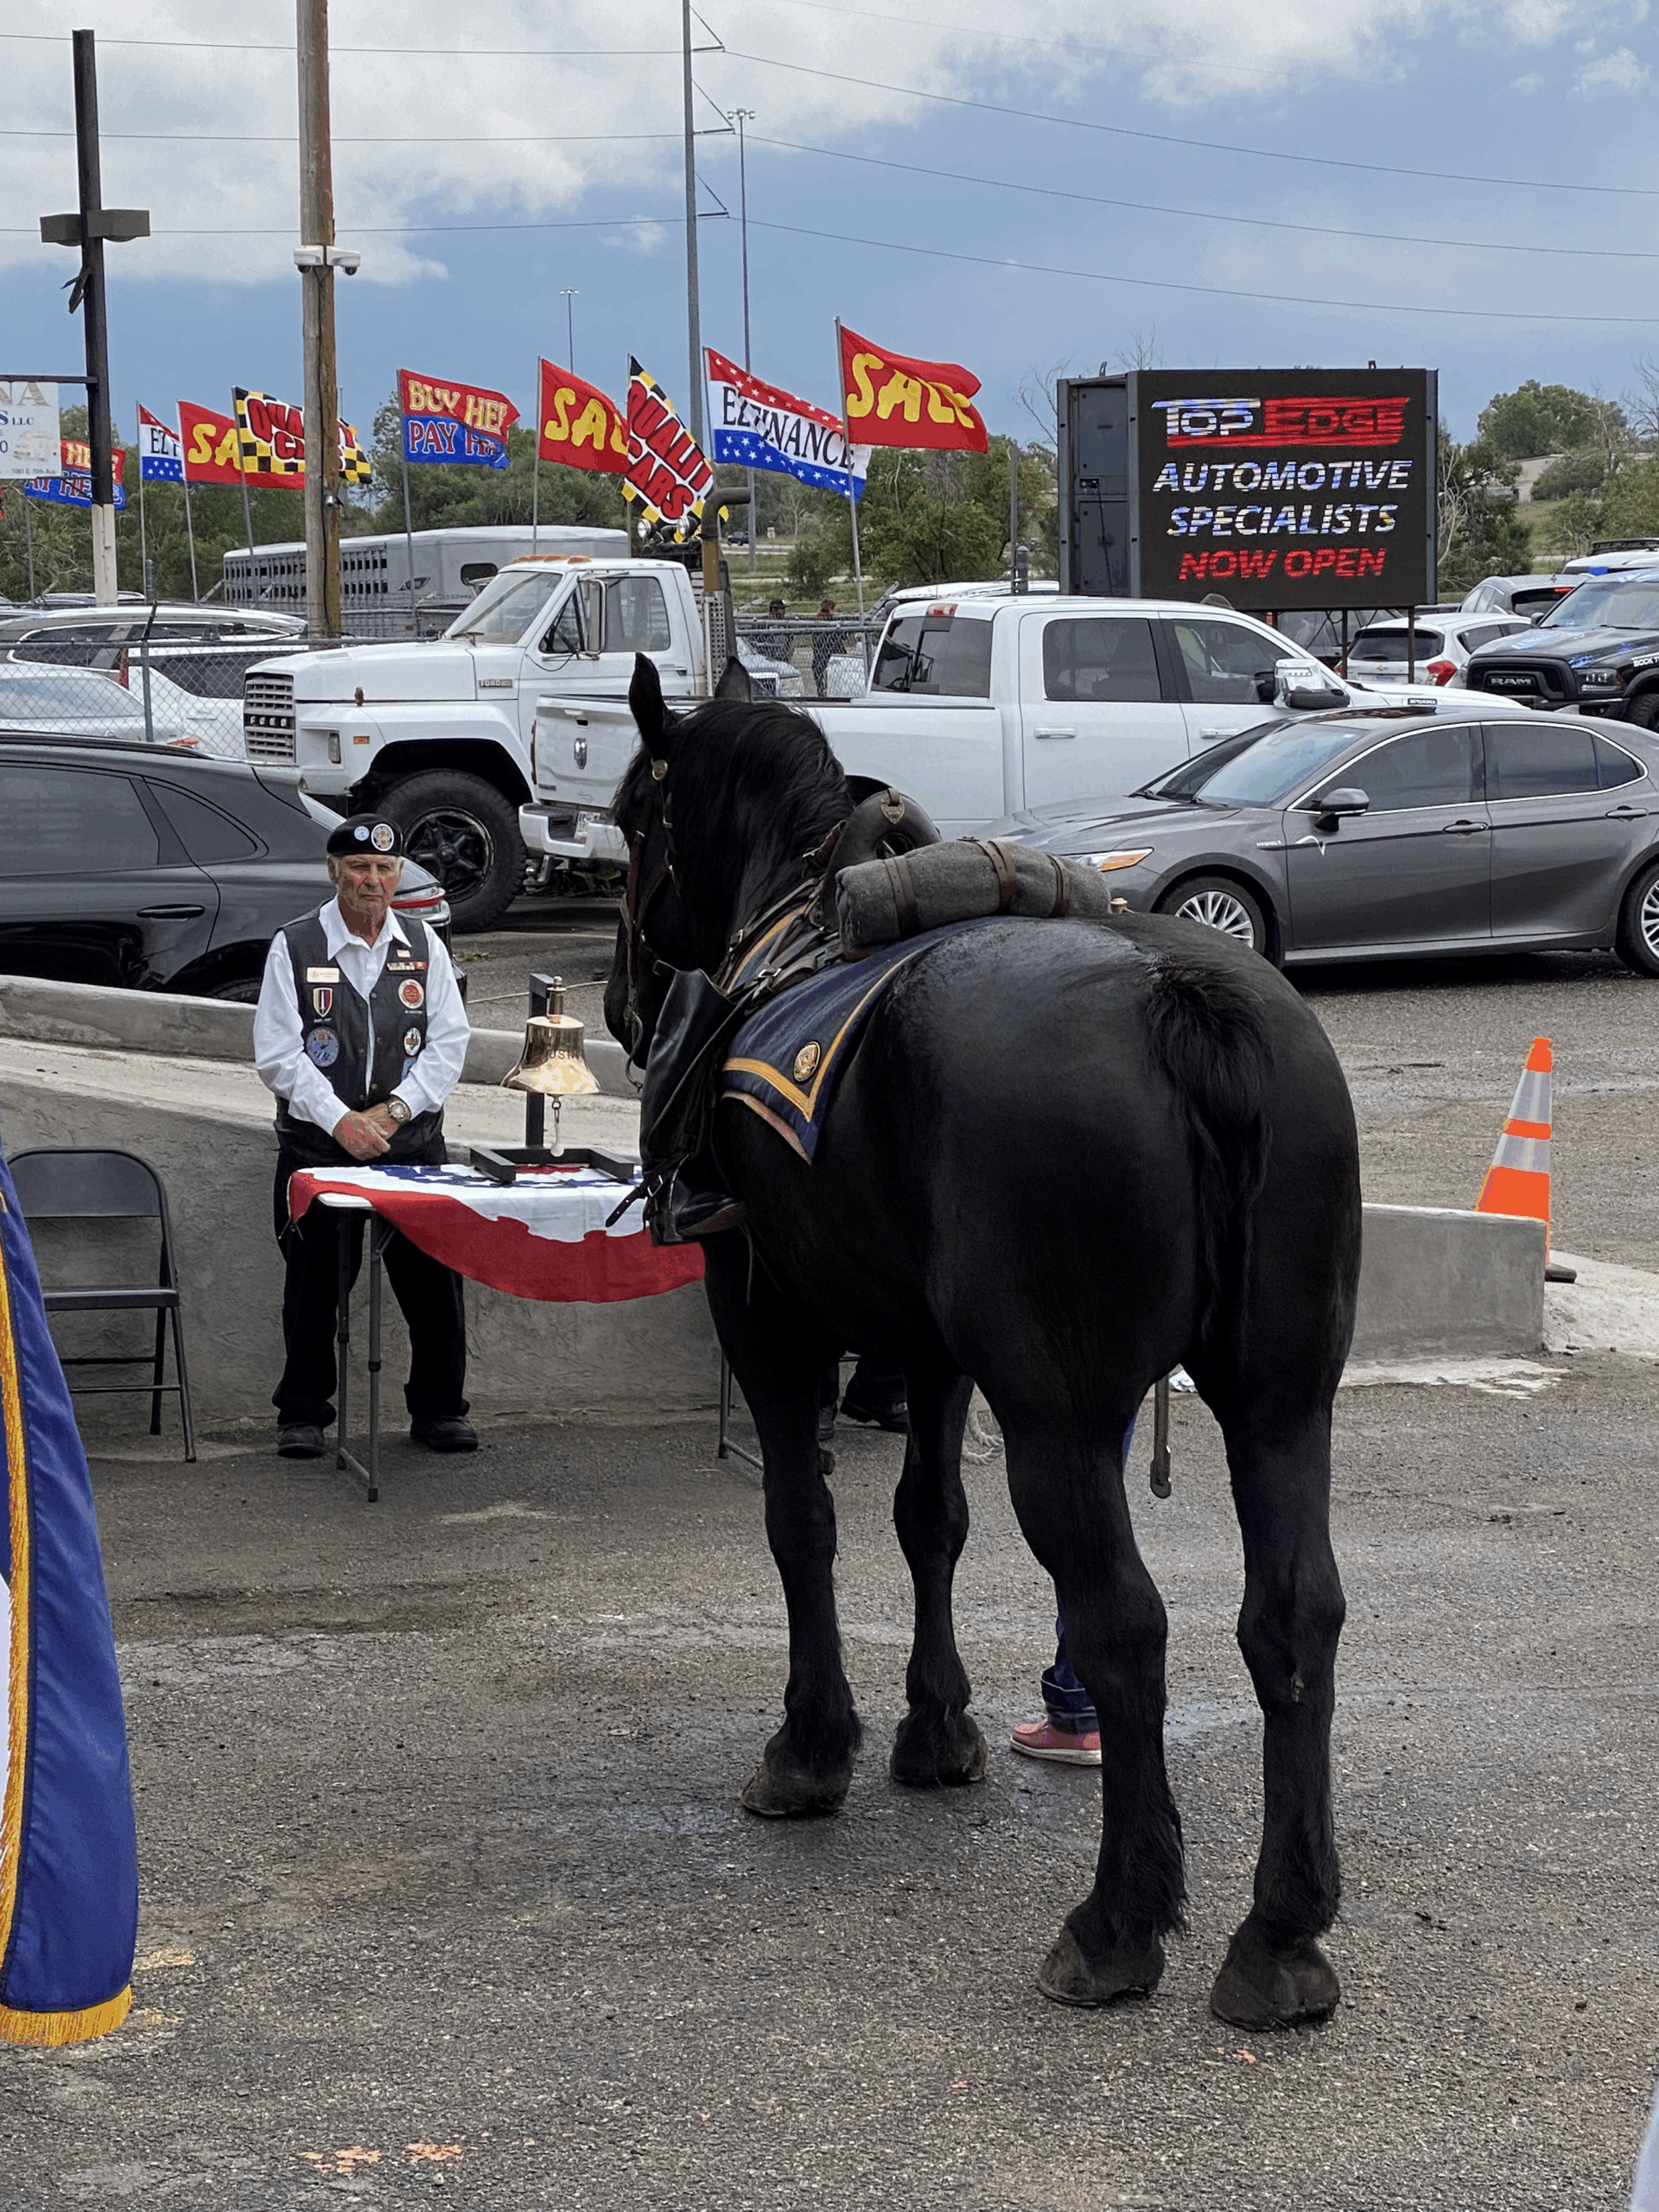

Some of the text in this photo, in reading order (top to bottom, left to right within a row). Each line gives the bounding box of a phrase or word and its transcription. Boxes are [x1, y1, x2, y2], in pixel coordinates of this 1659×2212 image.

[409, 379, 461, 416] BUY
[544, 387, 628, 455] SAL
[1151, 396, 1411, 436] TOP EDGE
[150, 427, 169, 455] EZ
[188, 423, 242, 471] SA
[409, 420, 459, 454] PAY
[1152, 460, 1414, 493] AUTOMOTIVE
[1166, 503, 1399, 537] SPECIALISTS
[1178, 547, 1388, 581] NOW OPEN
[250, 715, 287, 727] FORD
